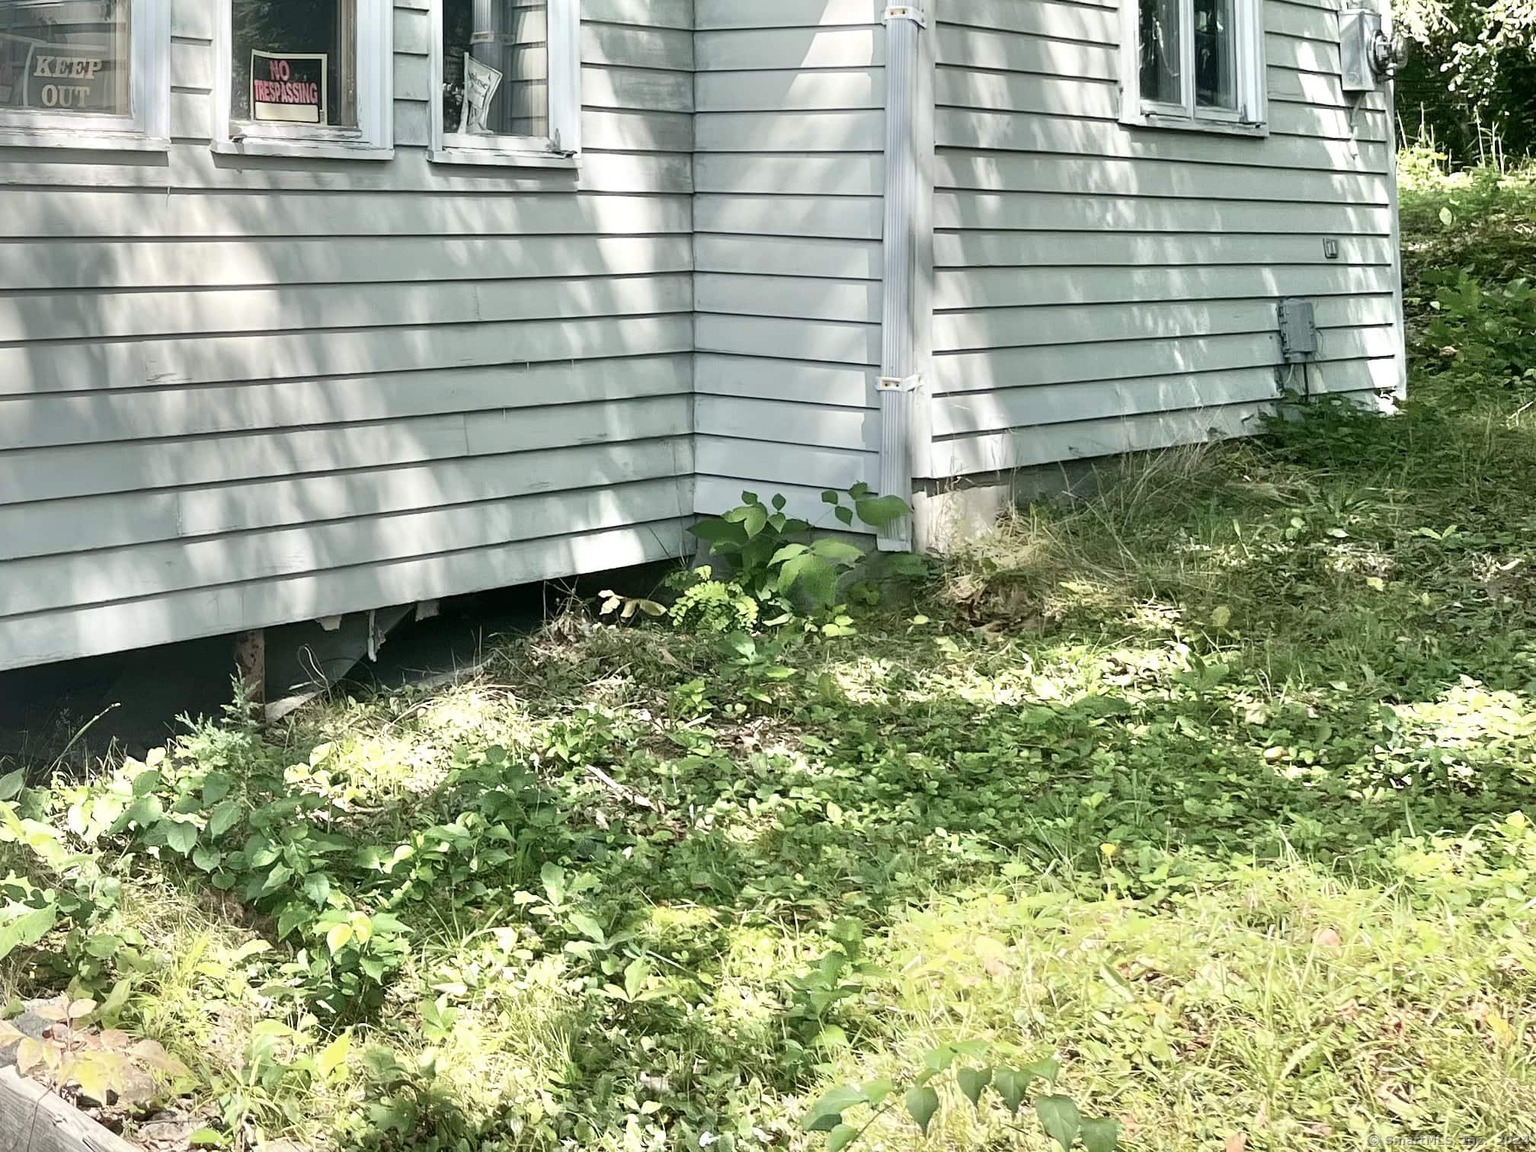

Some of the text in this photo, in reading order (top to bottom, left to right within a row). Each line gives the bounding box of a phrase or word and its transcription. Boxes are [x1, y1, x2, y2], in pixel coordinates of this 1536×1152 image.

[33, 55, 102, 80] KEEP
[269, 60, 291, 81] NO
[41, 84, 90, 107] OUT
[254, 79, 318, 104] TRESPASSING
